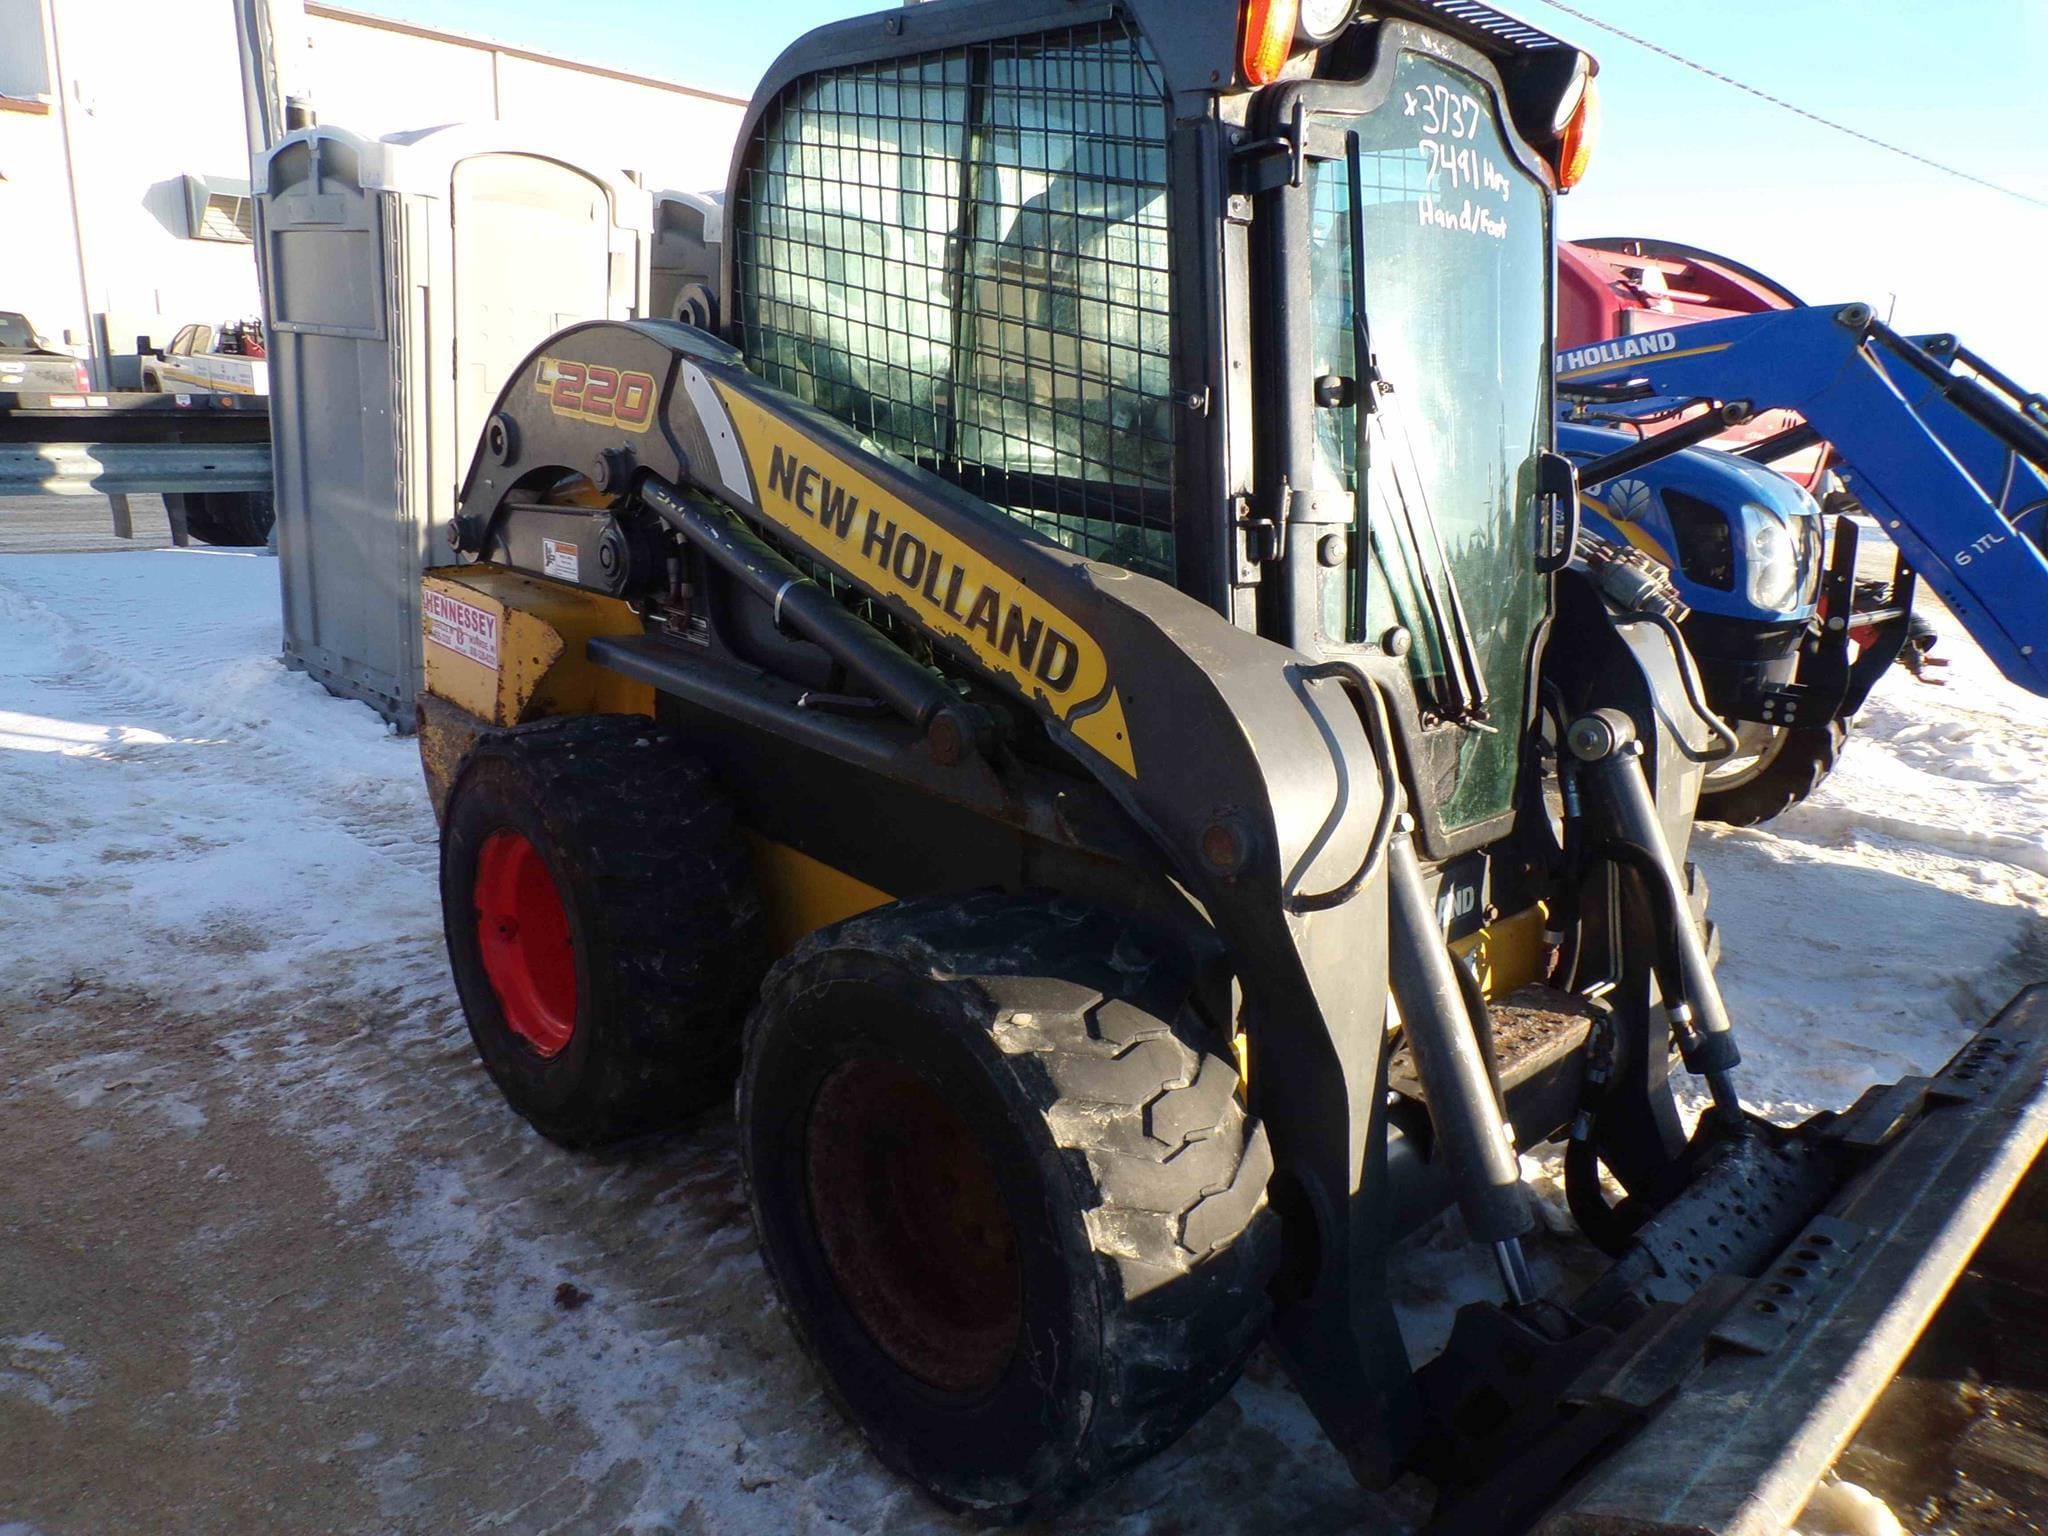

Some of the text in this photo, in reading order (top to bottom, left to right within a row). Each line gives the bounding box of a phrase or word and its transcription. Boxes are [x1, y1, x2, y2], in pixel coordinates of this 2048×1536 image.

[1418, 139, 1480, 190] 7491
[1567, 332, 1677, 371] HOLLAND
[768, 444, 1079, 693] NEW HOLLAND
[424, 591, 495, 639] HENNESSEY
